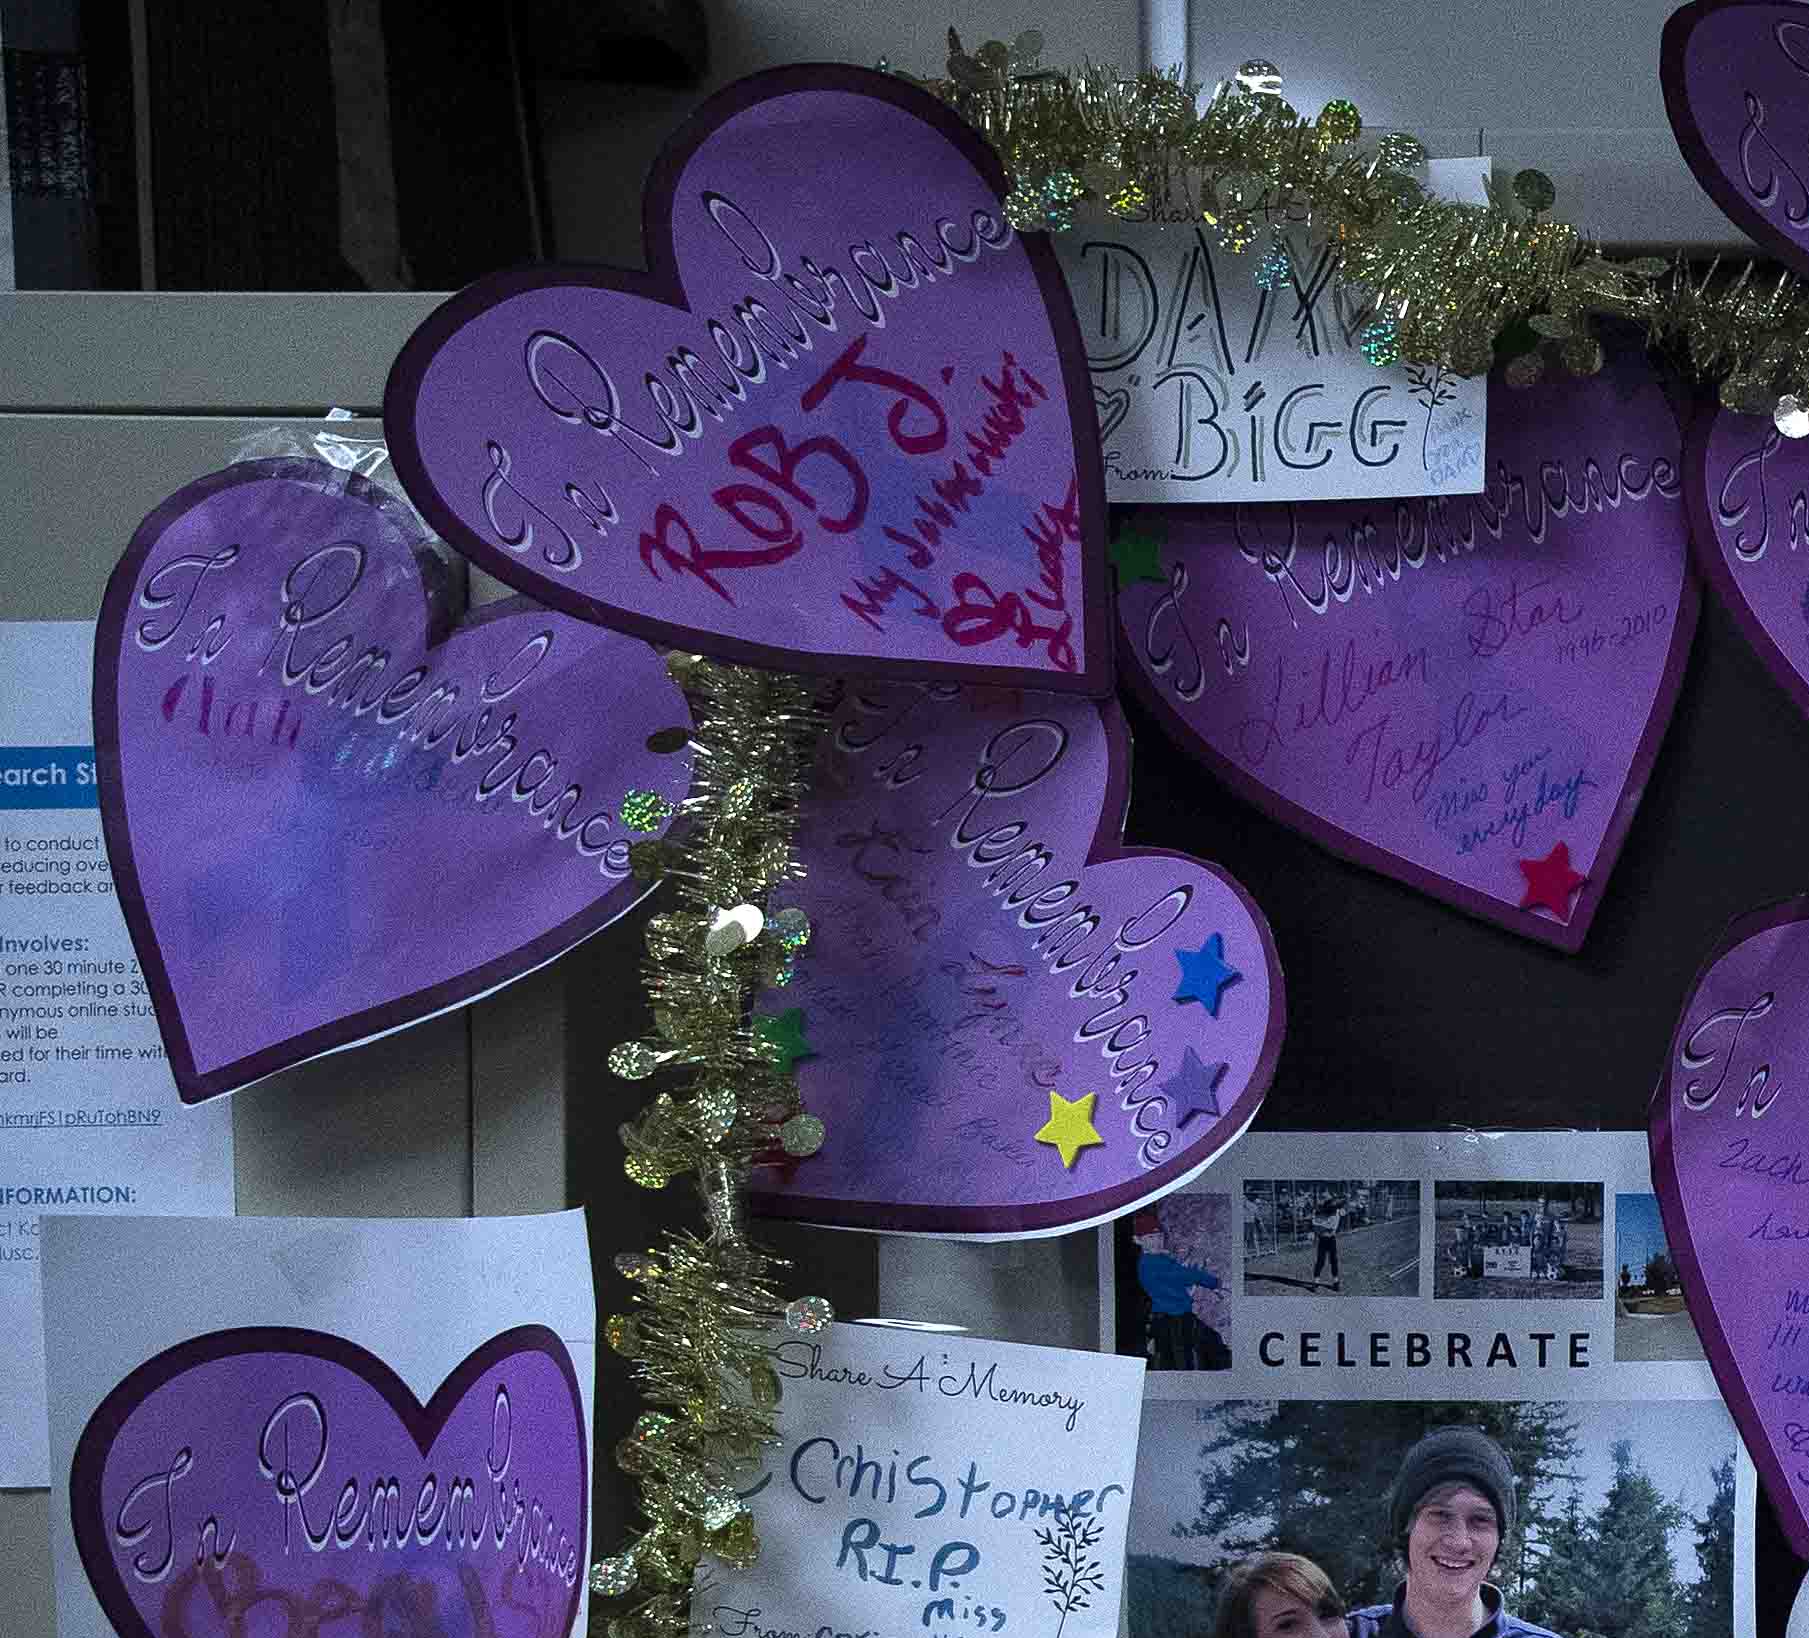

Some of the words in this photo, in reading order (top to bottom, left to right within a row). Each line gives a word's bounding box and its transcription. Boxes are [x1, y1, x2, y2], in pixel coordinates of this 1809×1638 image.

[524, 190, 1014, 477] Remembrance
[1681, 991, 1783, 1118] In
[777, 1340, 873, 1391] Share
[938, 1362, 1086, 1433] Memory
[1258, 1330, 1592, 1371] CELEBRATE
